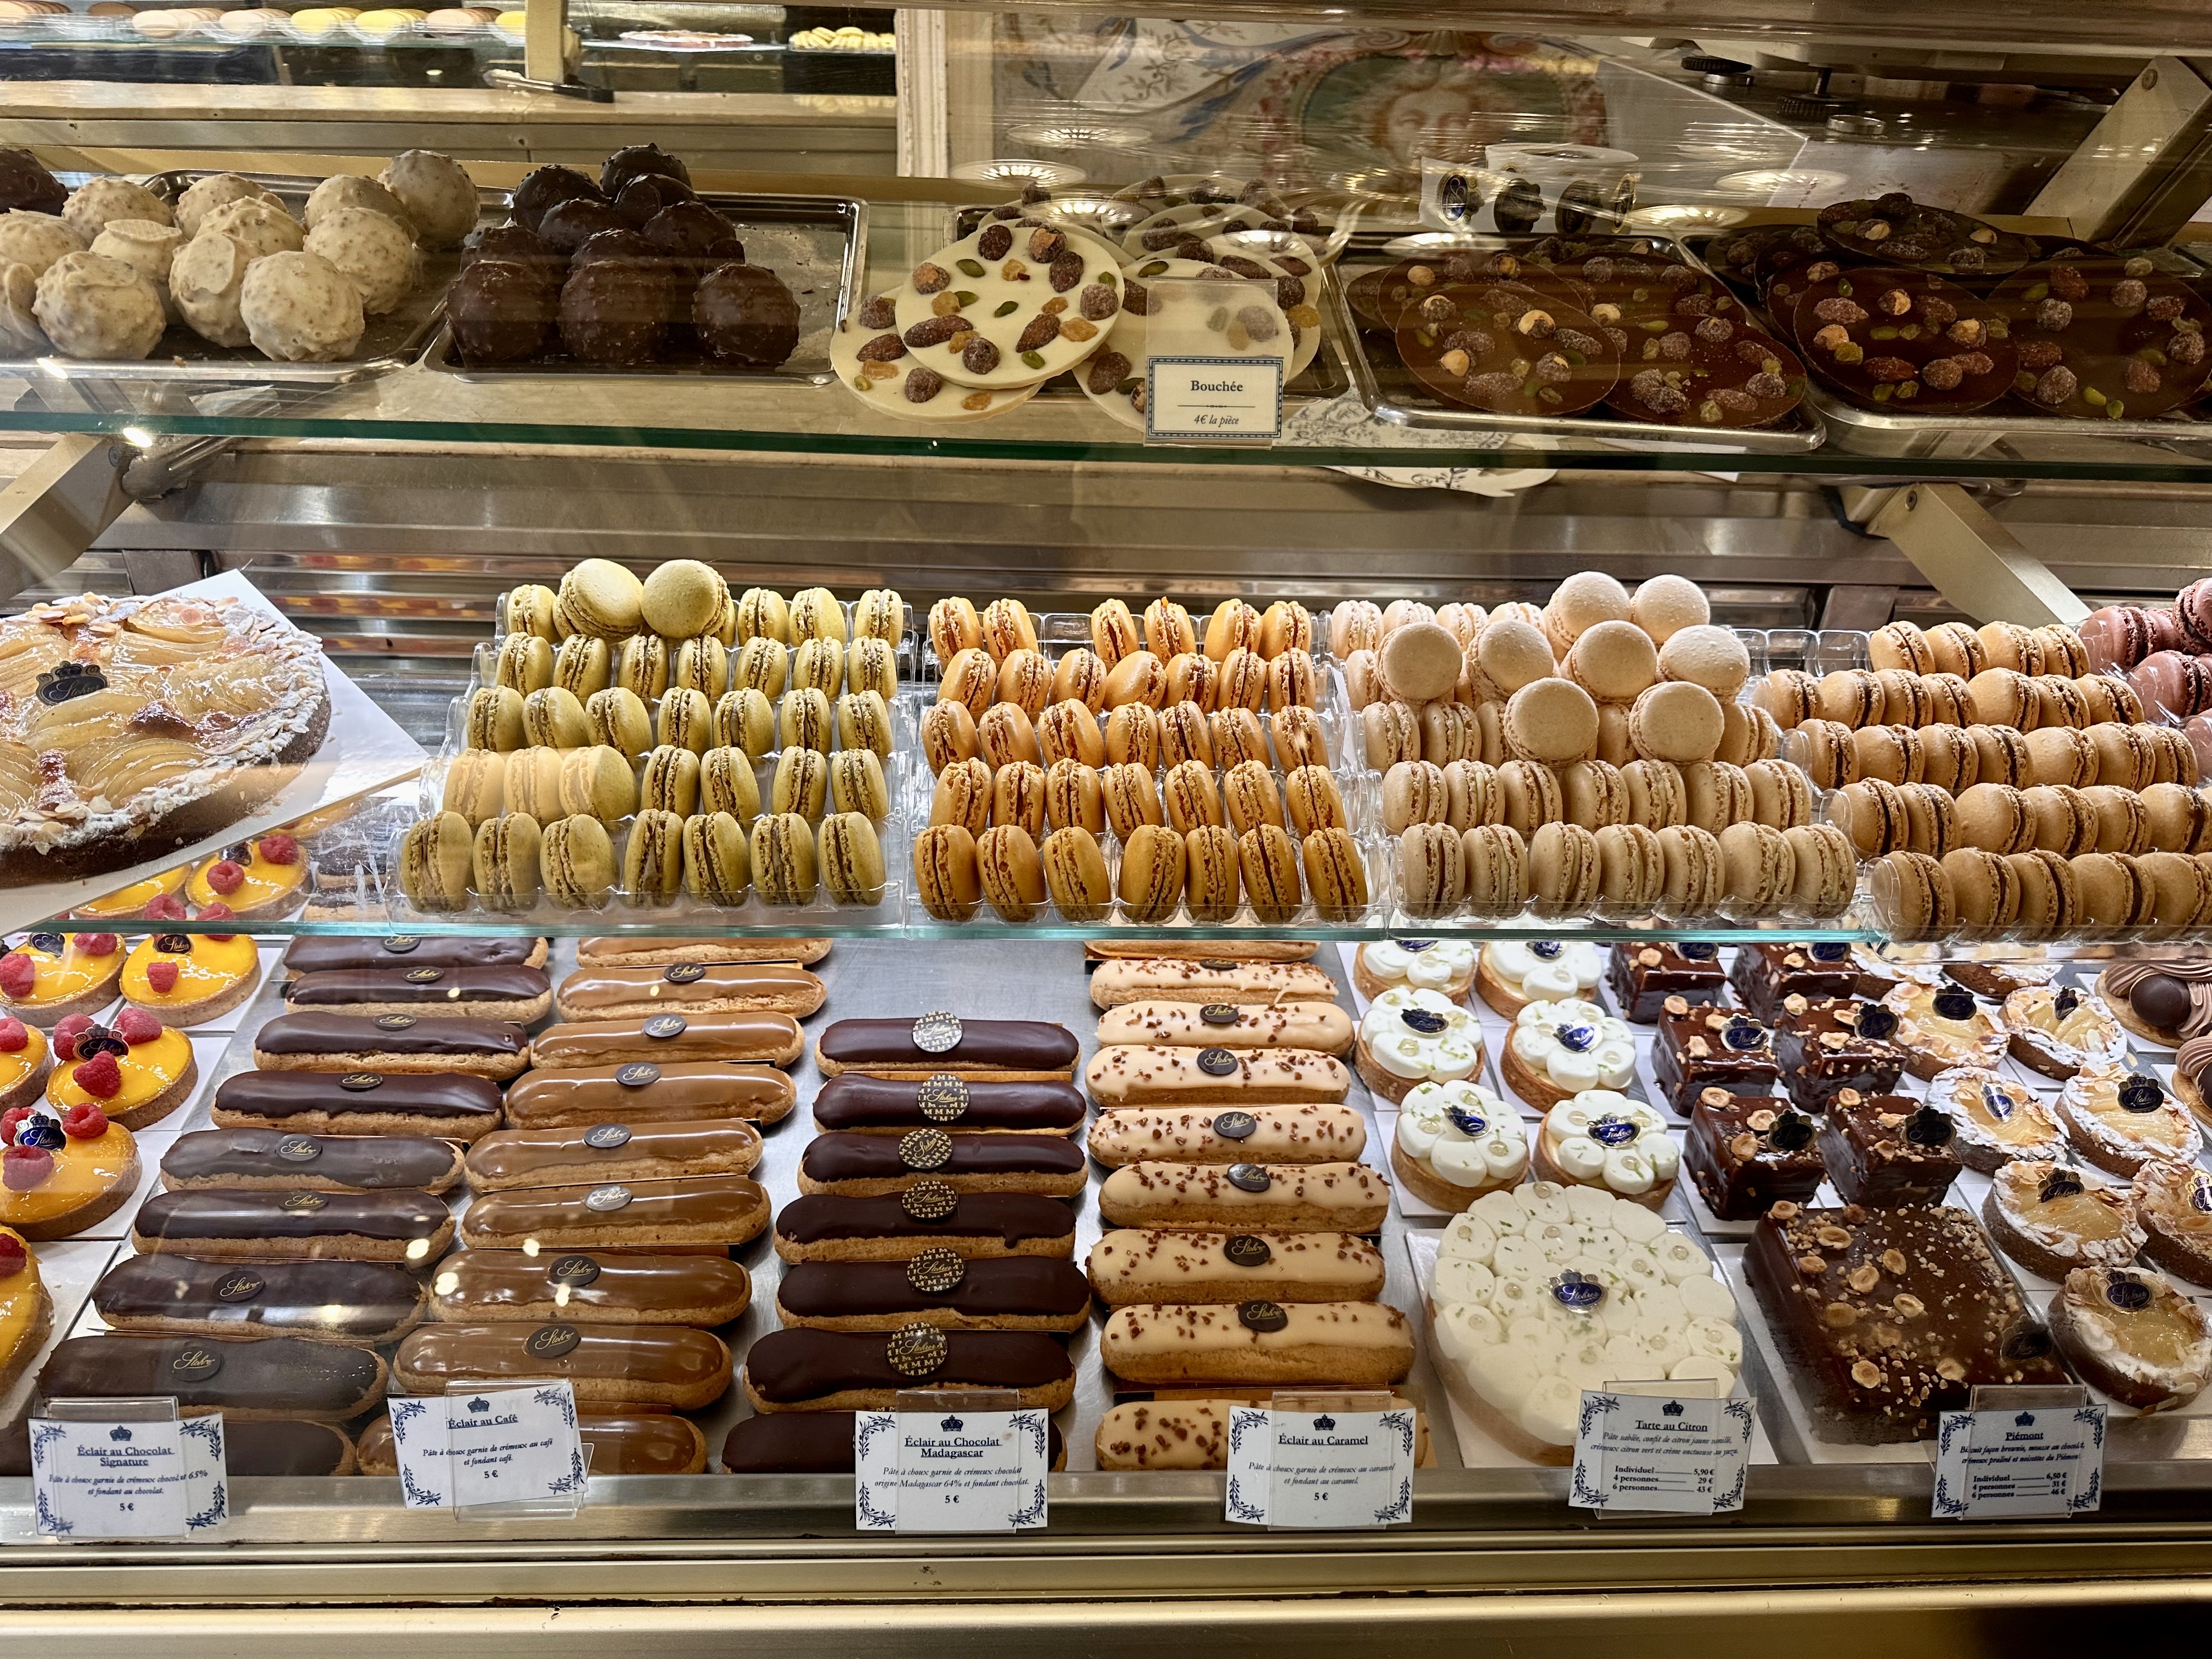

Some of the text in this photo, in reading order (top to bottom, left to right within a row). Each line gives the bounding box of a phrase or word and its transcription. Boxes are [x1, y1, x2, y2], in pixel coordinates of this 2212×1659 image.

[1190, 380, 1244, 392] Bouchée
[1194, 415, 1240, 427] 4€ la pièce
[448, 1418, 477, 1427] Éclair
[495, 1414, 518, 1424] Café
[1635, 1420, 1661, 1430] Tarte
[1678, 1422, 1707, 1431] Citron
[905, 1435, 936, 1446] Éclair
[953, 1437, 1000, 1446] Chocolat
[1278, 1433, 1309, 1444] Éclair
[1327, 1435, 1368, 1444] Caramel
[2005, 1431, 2044, 1441] Piémont
[77, 1444, 108, 1455] Éclair
[125, 1446, 172, 1455] Chocolat
[466, 1446, 488, 1456] garnie
[540, 1438, 553, 1448] café
[921, 1448, 984, 1459] Madagascar
[100, 1457, 149, 1468] Signature
[470, 1457, 498, 1467] fondant
[188, 1470, 208, 1479] 65%
[929, 1468, 952, 1477] garnie
[1294, 1466, 1318, 1475] garnie
[1615, 1465, 1655, 1474] Individuel
[874, 1479, 898, 1488] origine
[899, 1479, 943, 1489] Madagascar
[970, 1479, 999, 1489] fondant
[1290, 1477, 1319, 1486] fondant
[94, 1487, 122, 1497] fondant
[1979, 1484, 2016, 1492] personnes
[945, 1495, 960, 1503] 5 €
[1313, 1492, 1328, 1500] 5 €
[127, 1503, 134, 1511] €
